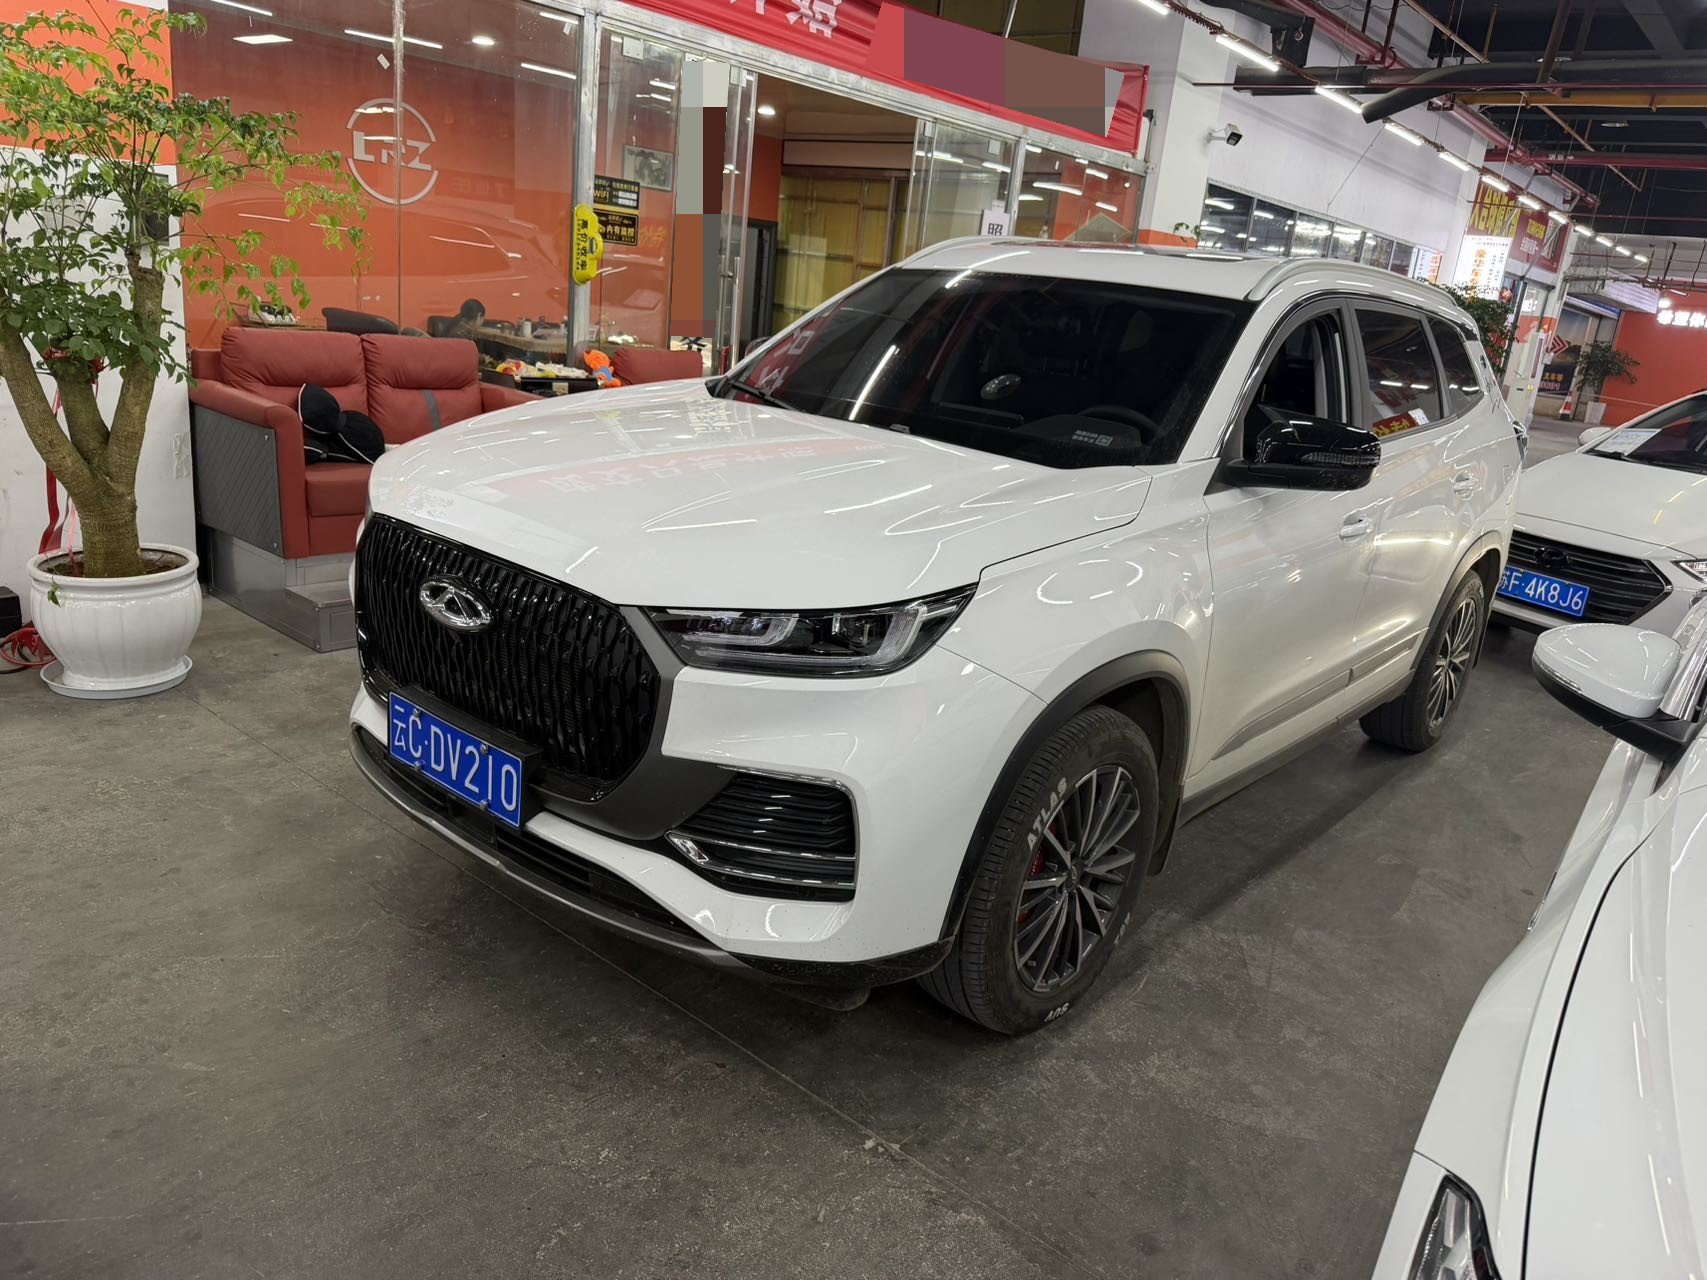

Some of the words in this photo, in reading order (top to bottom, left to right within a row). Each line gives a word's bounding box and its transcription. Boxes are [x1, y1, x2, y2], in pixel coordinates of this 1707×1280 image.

[393, 704, 518, 811] 云C·DV210
[1027, 777, 1068, 850] ATLAS
[1044, 1002, 1070, 1022] SUV
